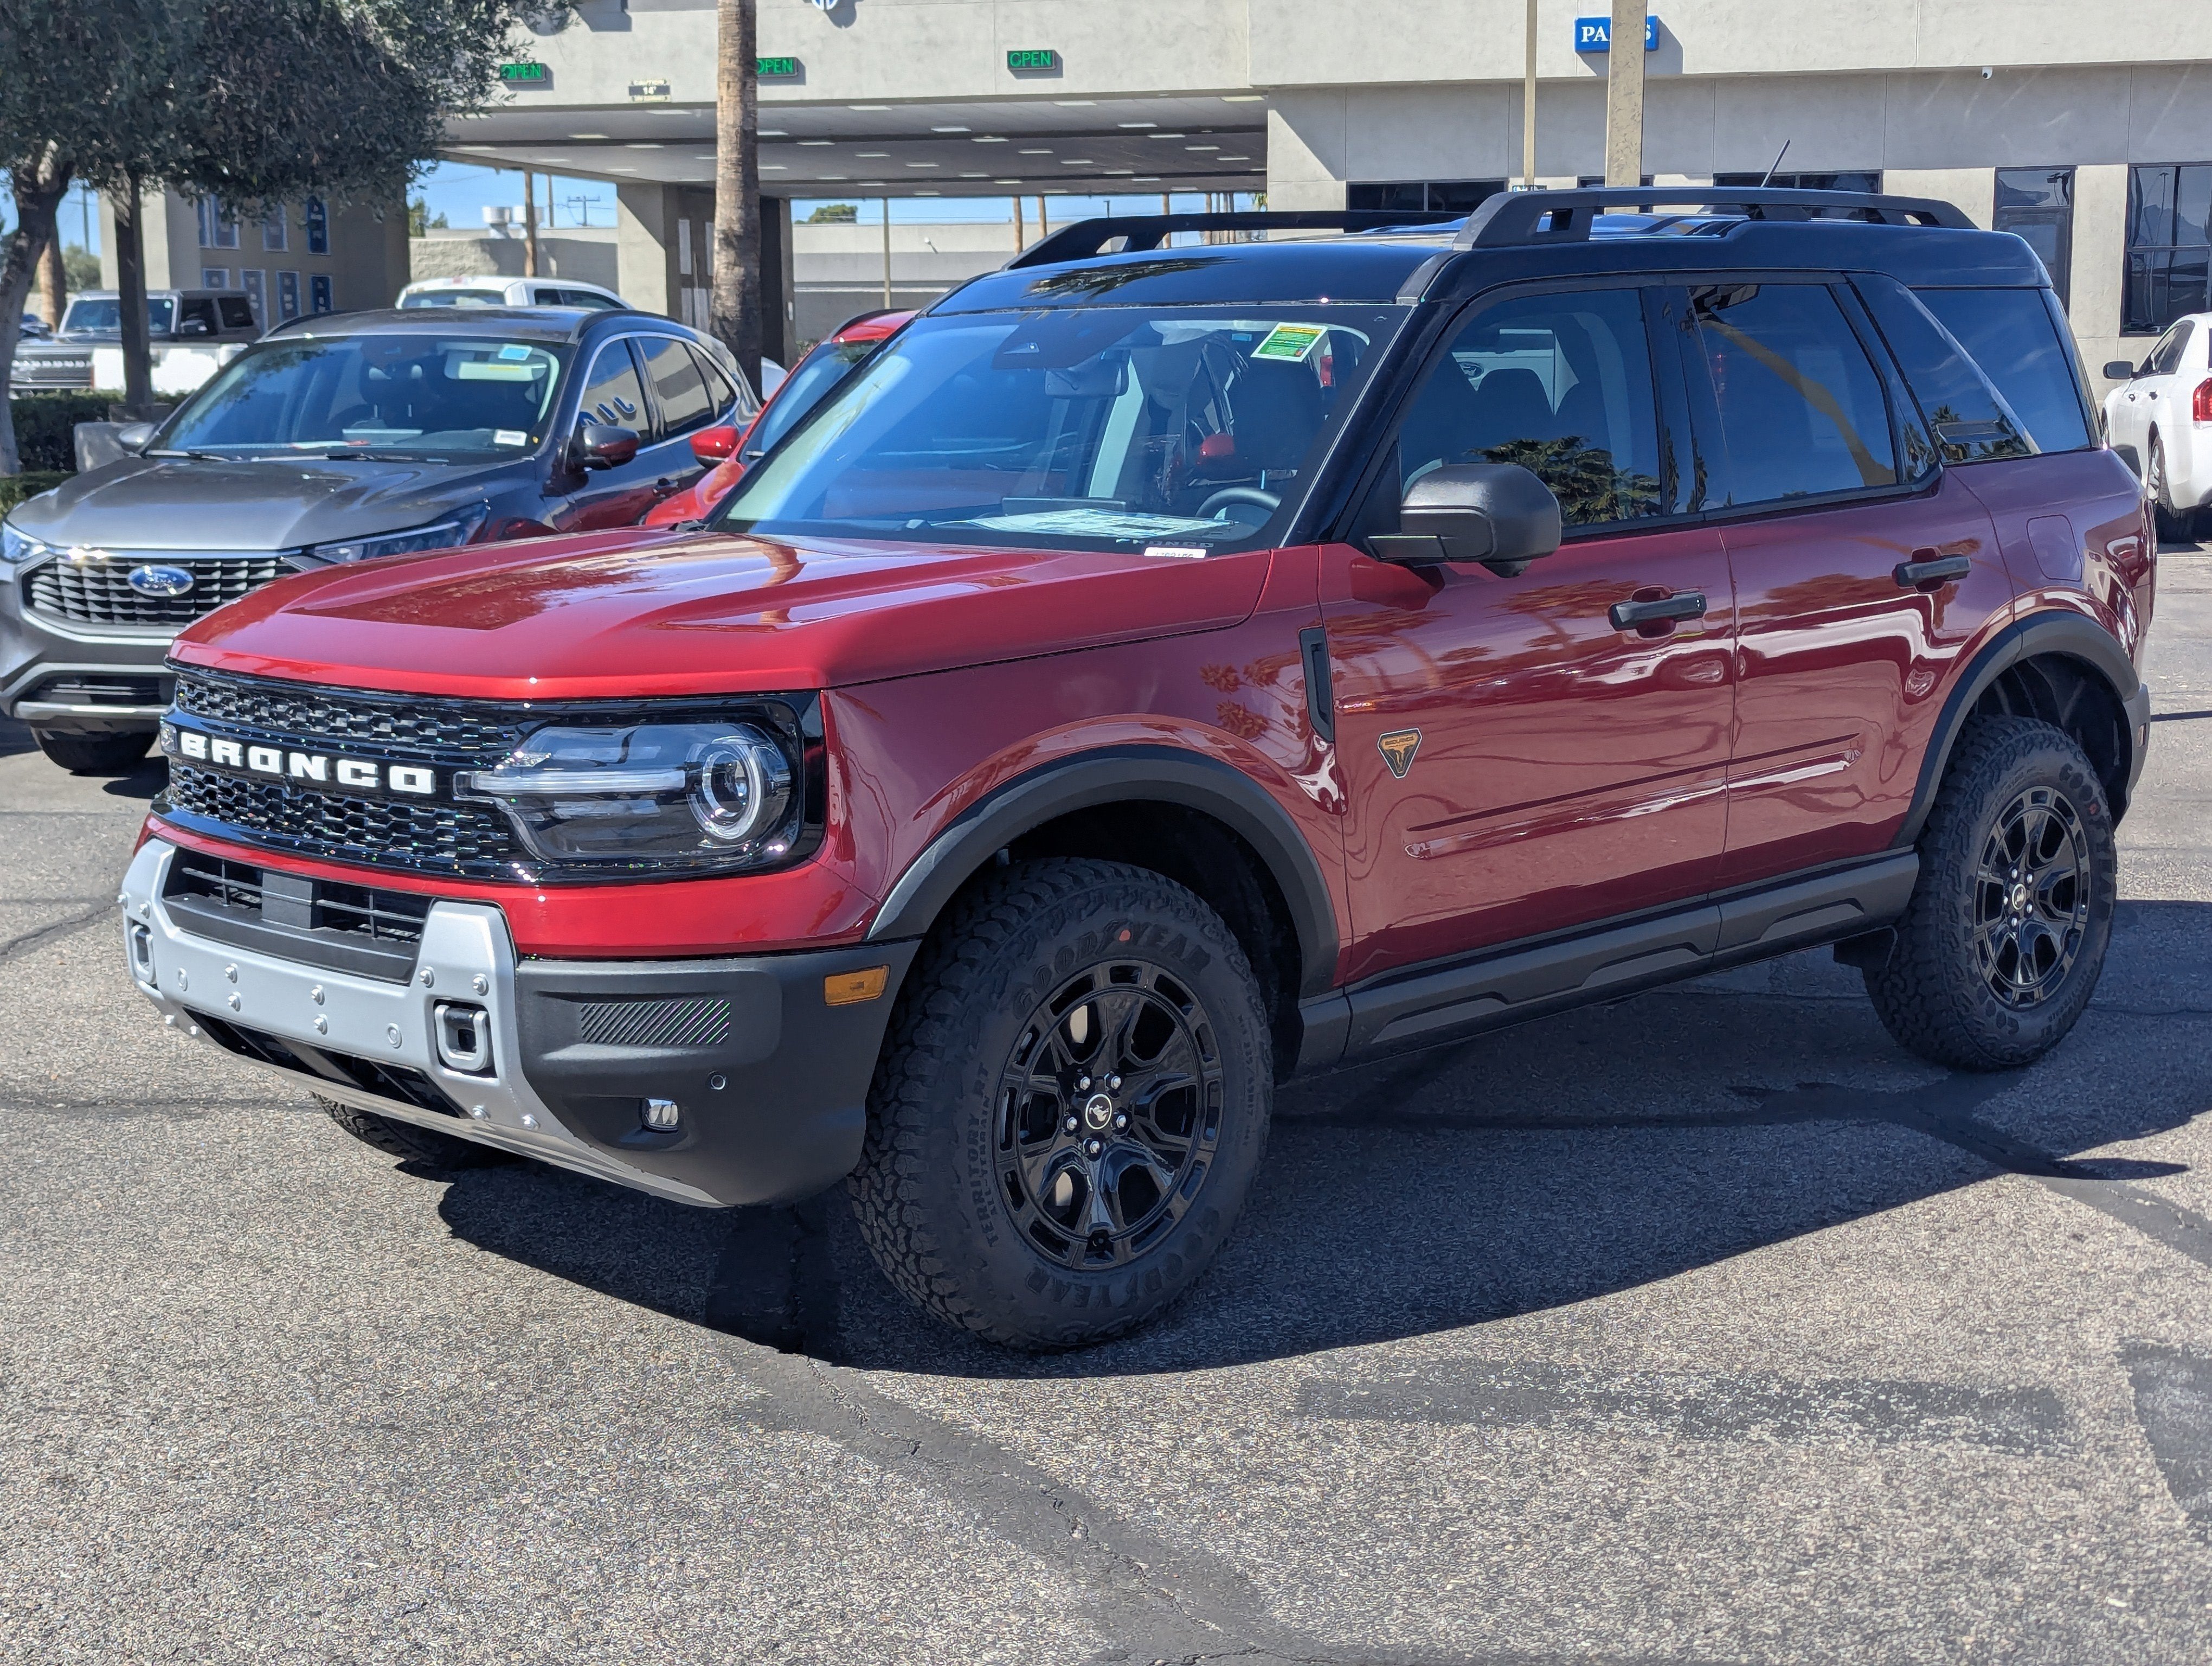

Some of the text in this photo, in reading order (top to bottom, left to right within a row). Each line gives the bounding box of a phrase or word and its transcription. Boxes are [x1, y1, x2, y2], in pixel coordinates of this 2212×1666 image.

[1581, 24, 1652, 42] PAS
[1009, 52, 1051, 67] OPEN
[181, 731, 435, 794] BRONCO
[967, 1113, 999, 1248] TERRITORY
